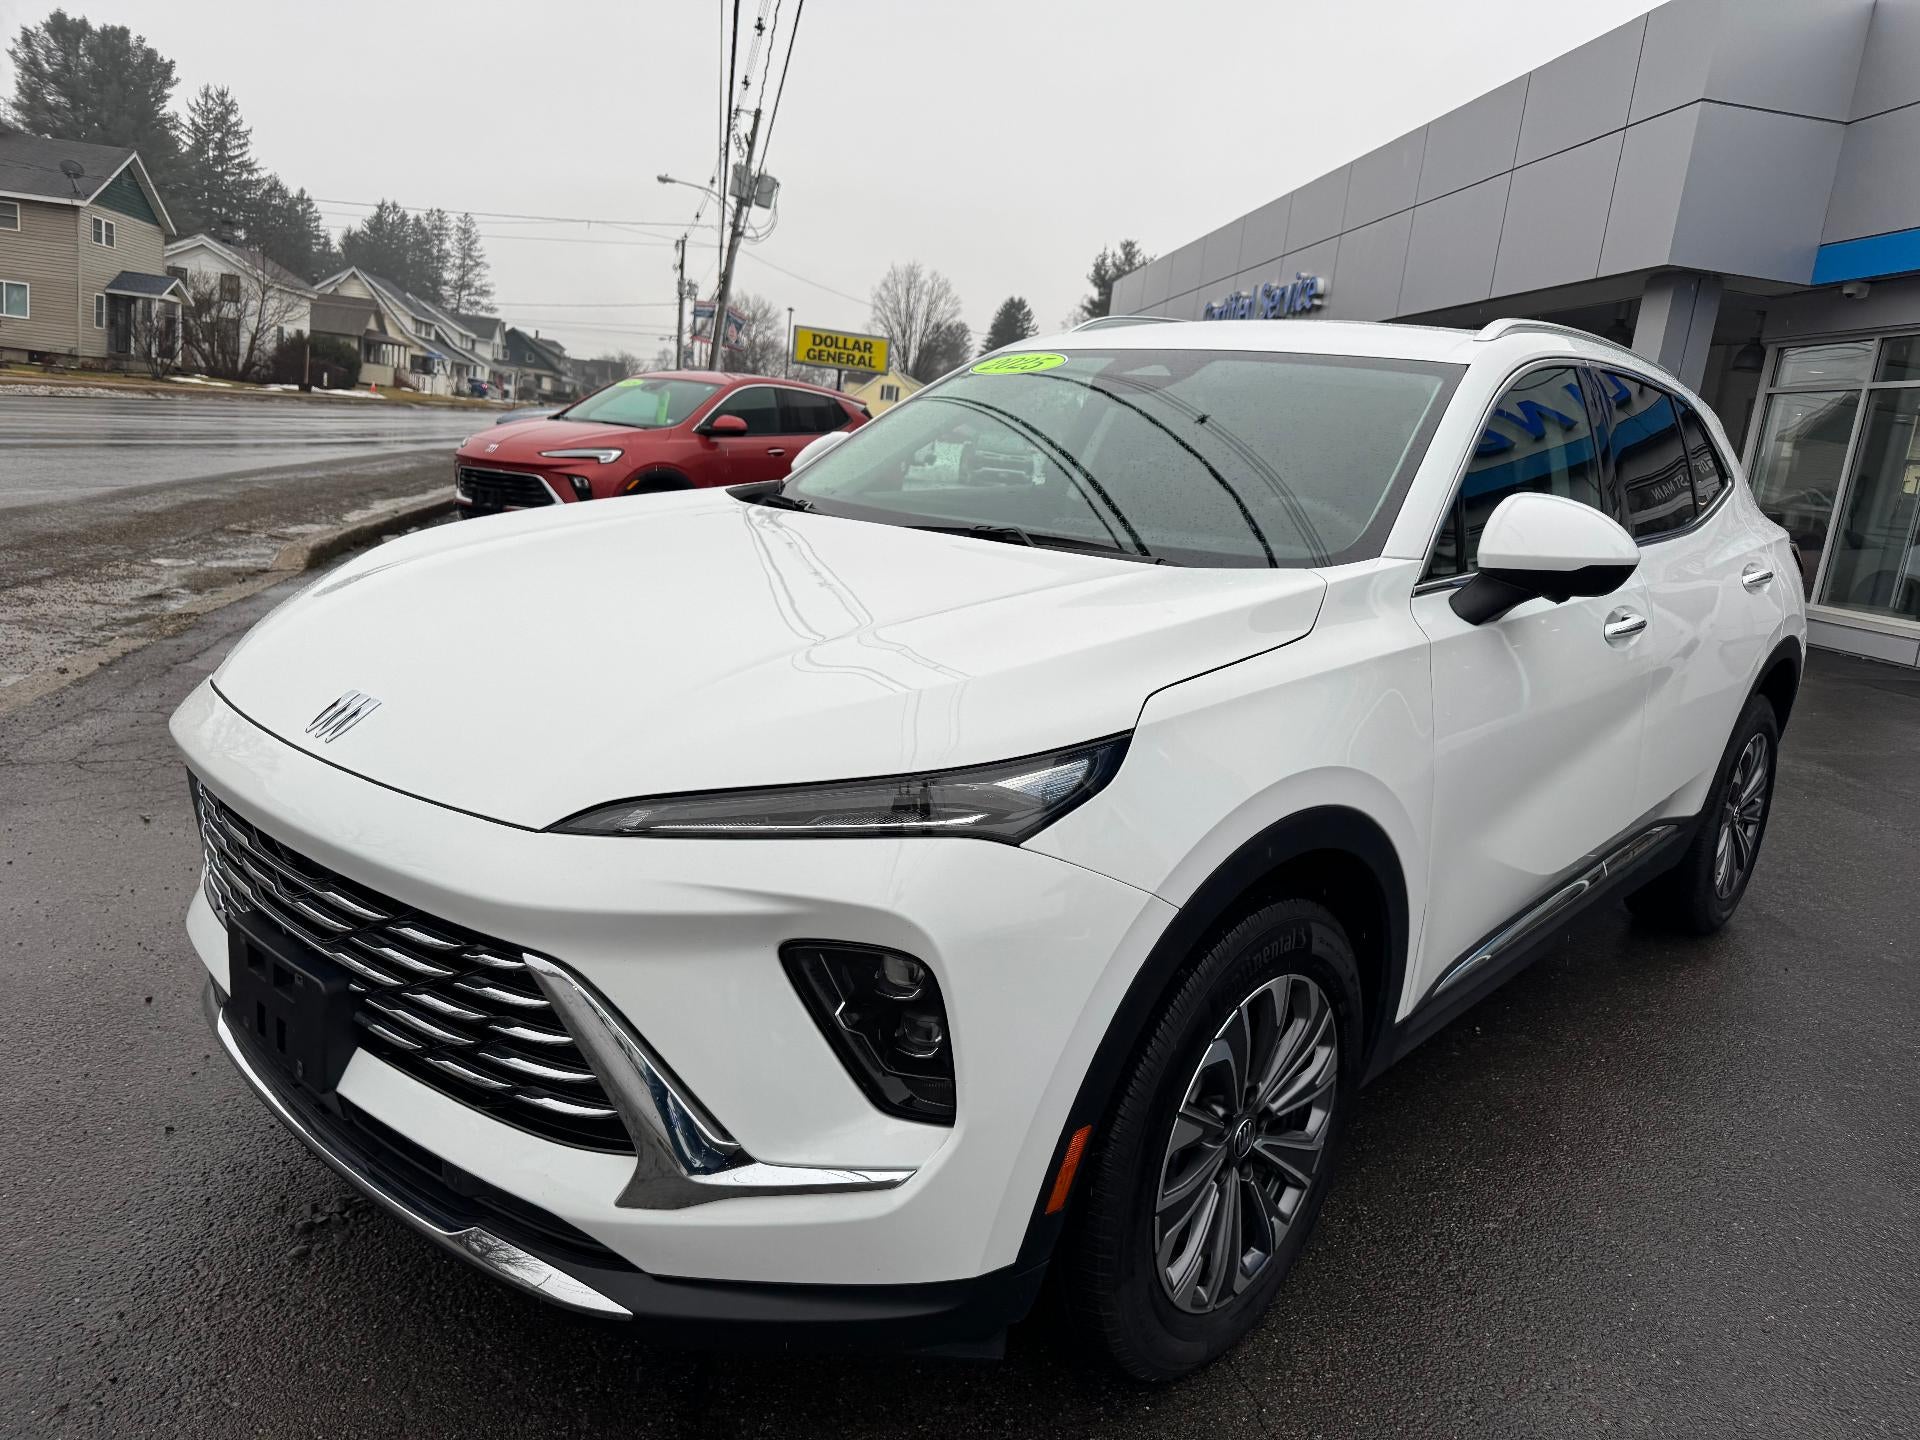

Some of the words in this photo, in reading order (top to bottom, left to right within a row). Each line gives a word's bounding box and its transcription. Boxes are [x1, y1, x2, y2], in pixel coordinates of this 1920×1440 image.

[1262, 271, 1324, 319] Service
[811, 333, 874, 354] DOLLAR
[806, 347, 877, 369] GENERAL
